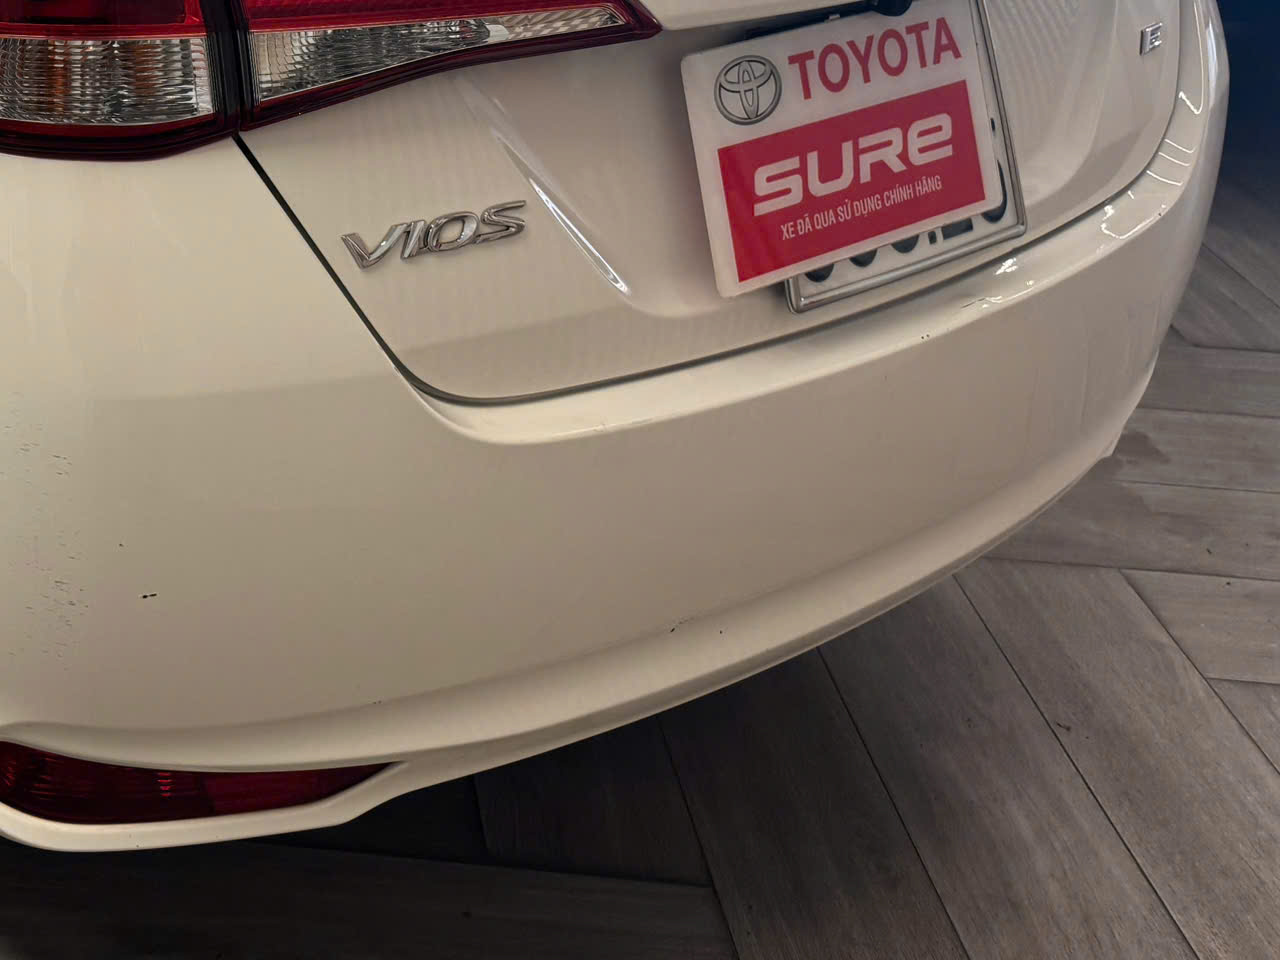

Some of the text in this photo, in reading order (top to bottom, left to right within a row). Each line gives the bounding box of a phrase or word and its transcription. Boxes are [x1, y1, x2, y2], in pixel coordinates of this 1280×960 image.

[786, 16, 963, 100] TOYOTA
[340, 199, 528, 270] VIOS
[781, 221, 796, 241] XE
[797, 214, 813, 236] ĐÃ
[814, 209, 837, 229] QUA
[837, 199, 852, 222] SỬ
[853, 194, 883, 218] DỤNG
[883, 183, 914, 207] CHÍNH
